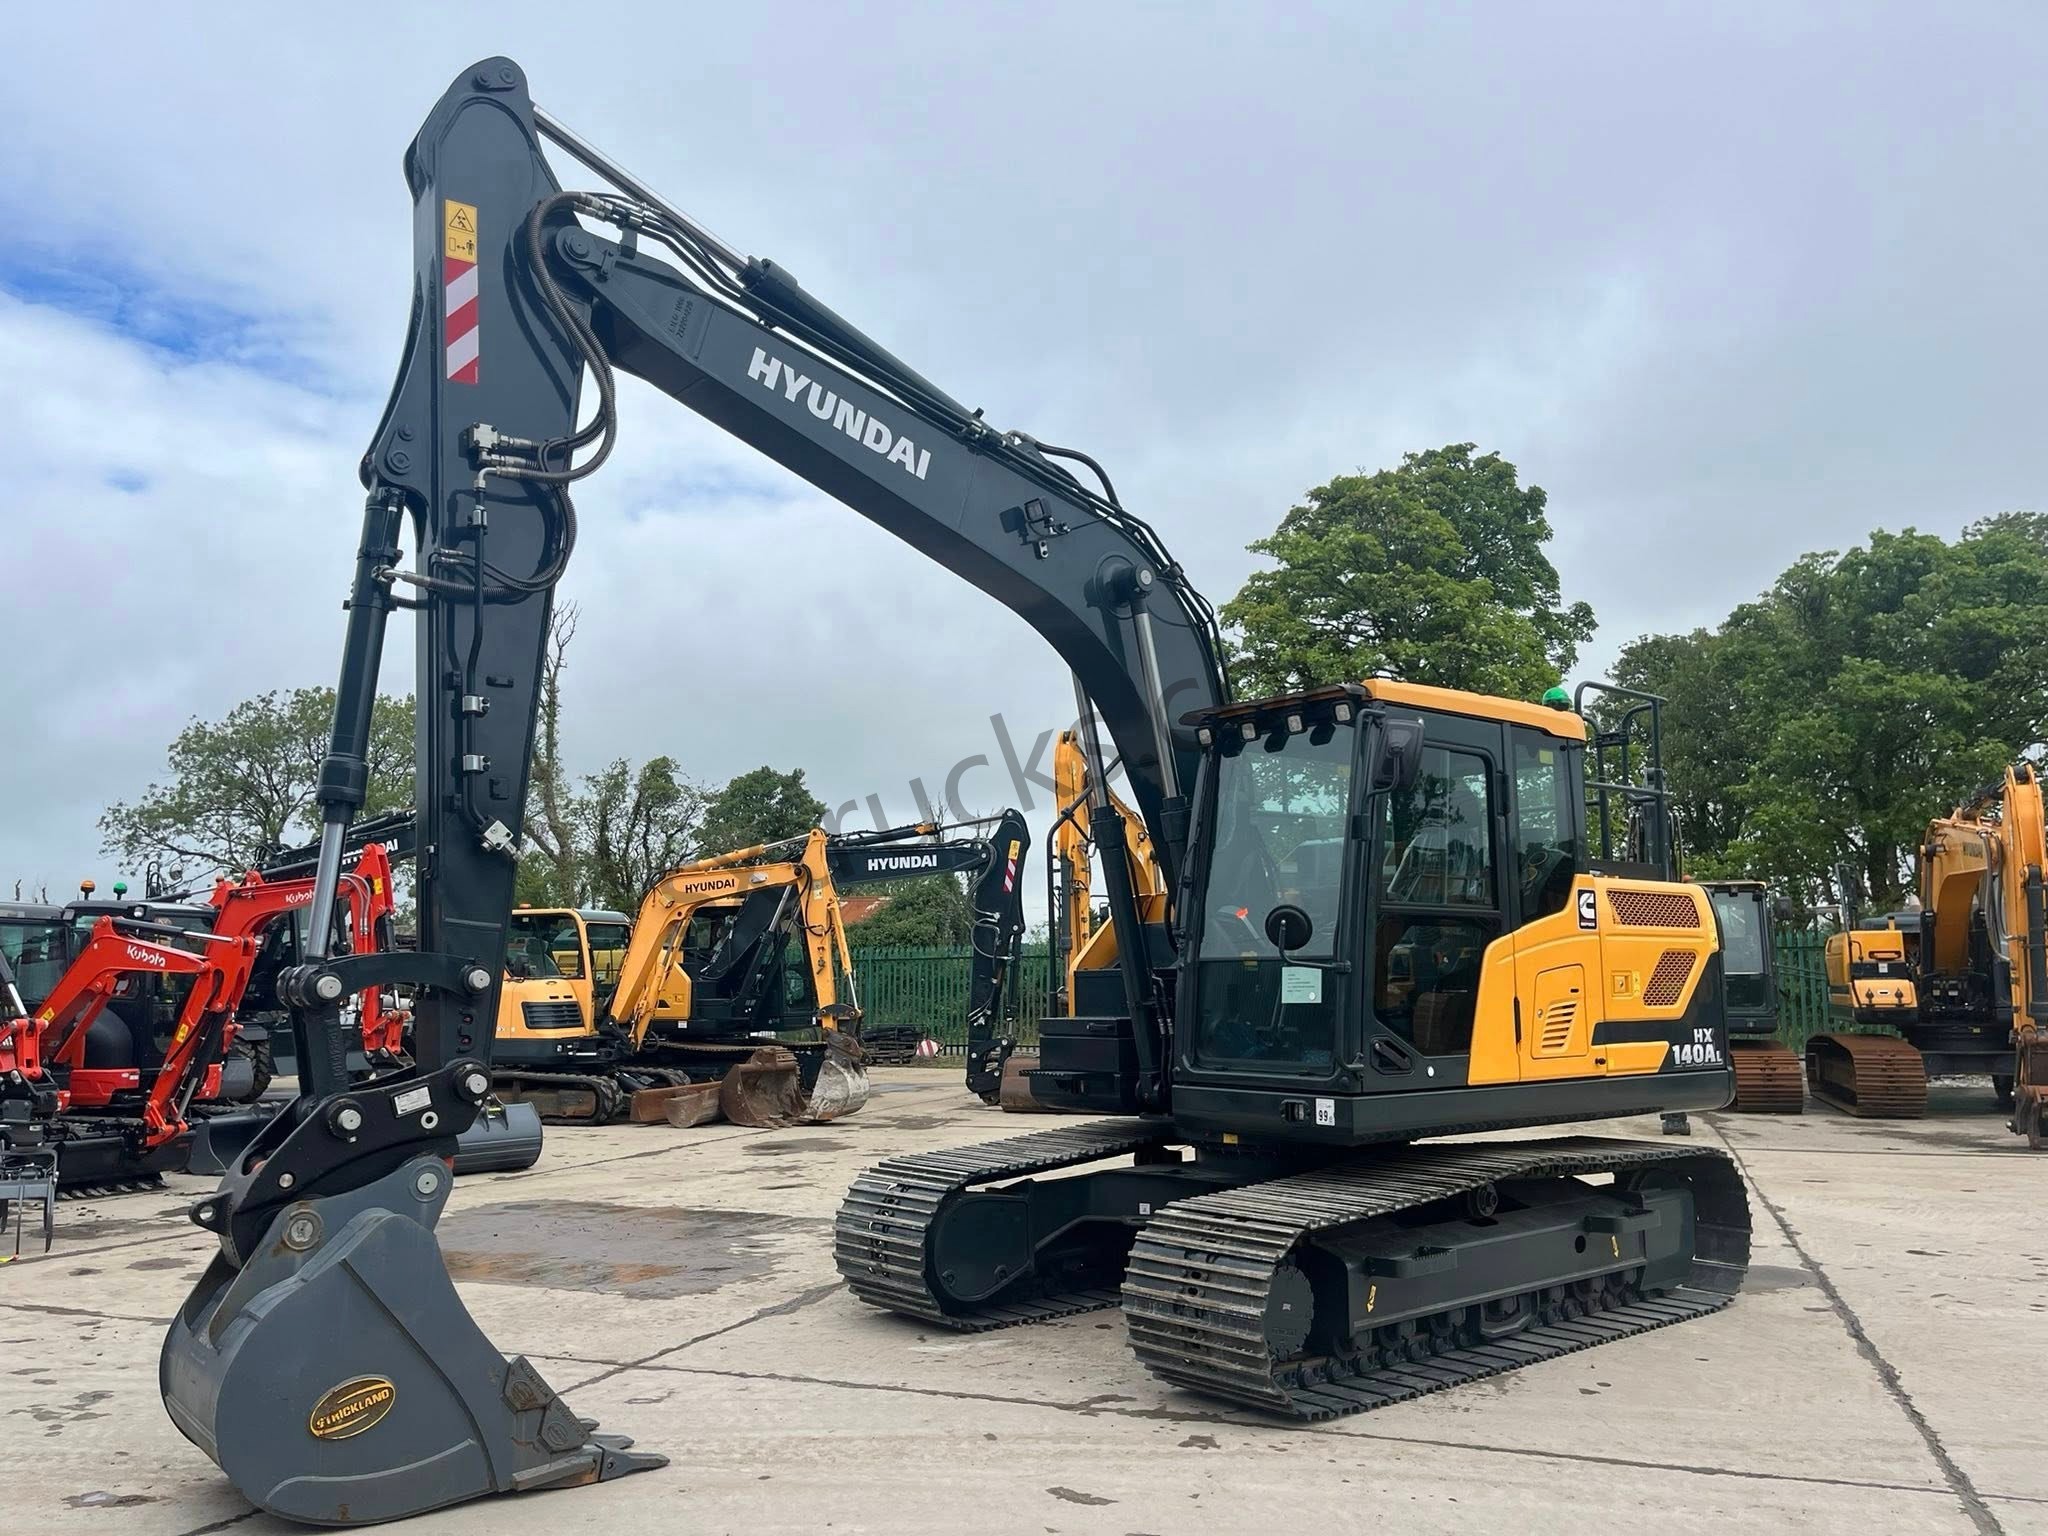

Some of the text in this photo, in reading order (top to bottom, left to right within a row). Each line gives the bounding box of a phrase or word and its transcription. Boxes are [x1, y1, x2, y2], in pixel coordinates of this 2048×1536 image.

[747, 347, 933, 481] HYUNDAI
[867, 854, 938, 872] HYUNDAI
[684, 877, 736, 895] HYUNDAI
[285, 888, 315, 904] Kubot
[126, 944, 166, 968] Kubota
[1693, 1028, 1713, 1043] HX
[1318, 1109, 1329, 1122] 99
[315, 1388, 390, 1429] STRICKLAND
